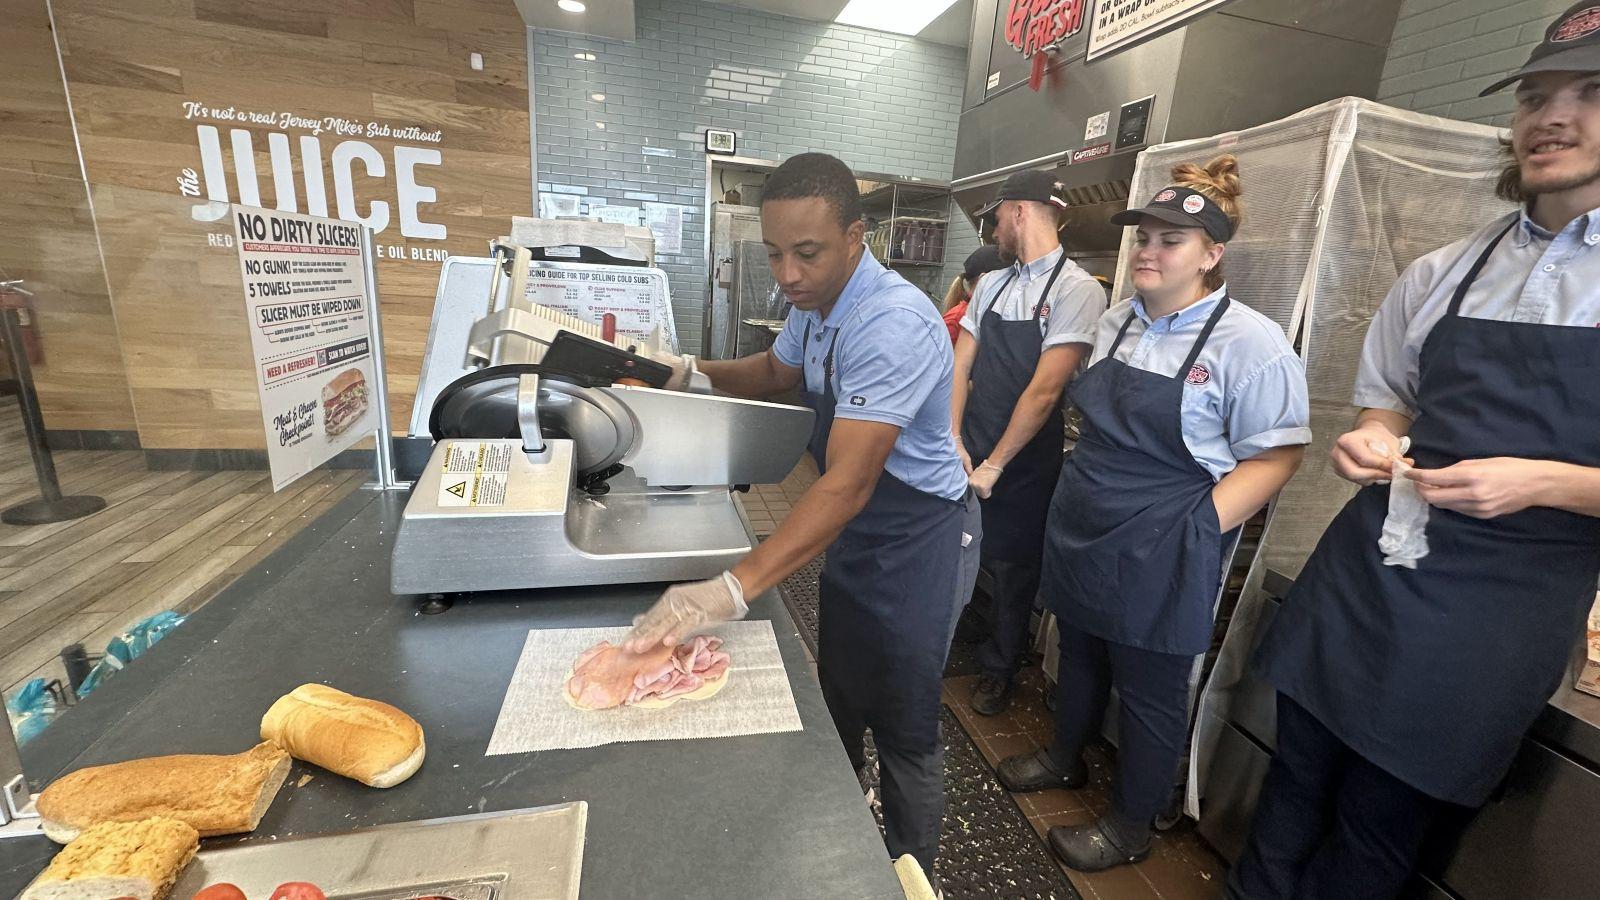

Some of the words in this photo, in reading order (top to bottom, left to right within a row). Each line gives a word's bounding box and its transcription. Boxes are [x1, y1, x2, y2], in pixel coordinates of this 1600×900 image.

[1099, 16, 1107, 29] IN
[1109, 12, 1114, 24] A
[1118, 0, 1141, 20] WRAP
[1024, 0, 1081, 56] FRESH
[182, 102, 208, 119] It's
[212, 106, 236, 120] not
[237, 111, 248, 122] a
[249, 112, 277, 124] real
[280, 112, 324, 135] Jersey
[324, 118, 363, 135] Mike's
[366, 122, 390, 138] Sub
[392, 127, 442, 142] without
[176, 168, 200, 196] the
[192, 124, 447, 240] JUICE
[208, 233, 232, 248] RED
[238, 212, 266, 240] NO
[270, 218, 312, 244] DIRTY
[316, 224, 360, 248] SLICERS!
[388, 246, 407, 260] OIL
[411, 248, 448, 262] BLEND
[245, 260, 260, 275] NO
[263, 260, 290, 275] GUNK!
[528, 270, 546, 278] ICING
[592, 274, 615, 282] SELLING
[634, 276, 649, 284] SUBS
[249, 283, 255, 298] 5
[258, 281, 291, 297] TOWELS
[261, 306, 289, 324] SLICER
[290, 304, 310, 318] MUST
[312, 303, 321, 316] BE
[322, 301, 342, 314] WIPED
[343, 299, 361, 311] DOWN
[266, 368, 282, 378] NEED
[282, 366, 287, 374] A
[274, 410, 292, 430] Meat
[292, 404, 298, 422] &
[298, 400, 317, 419] Cheese
